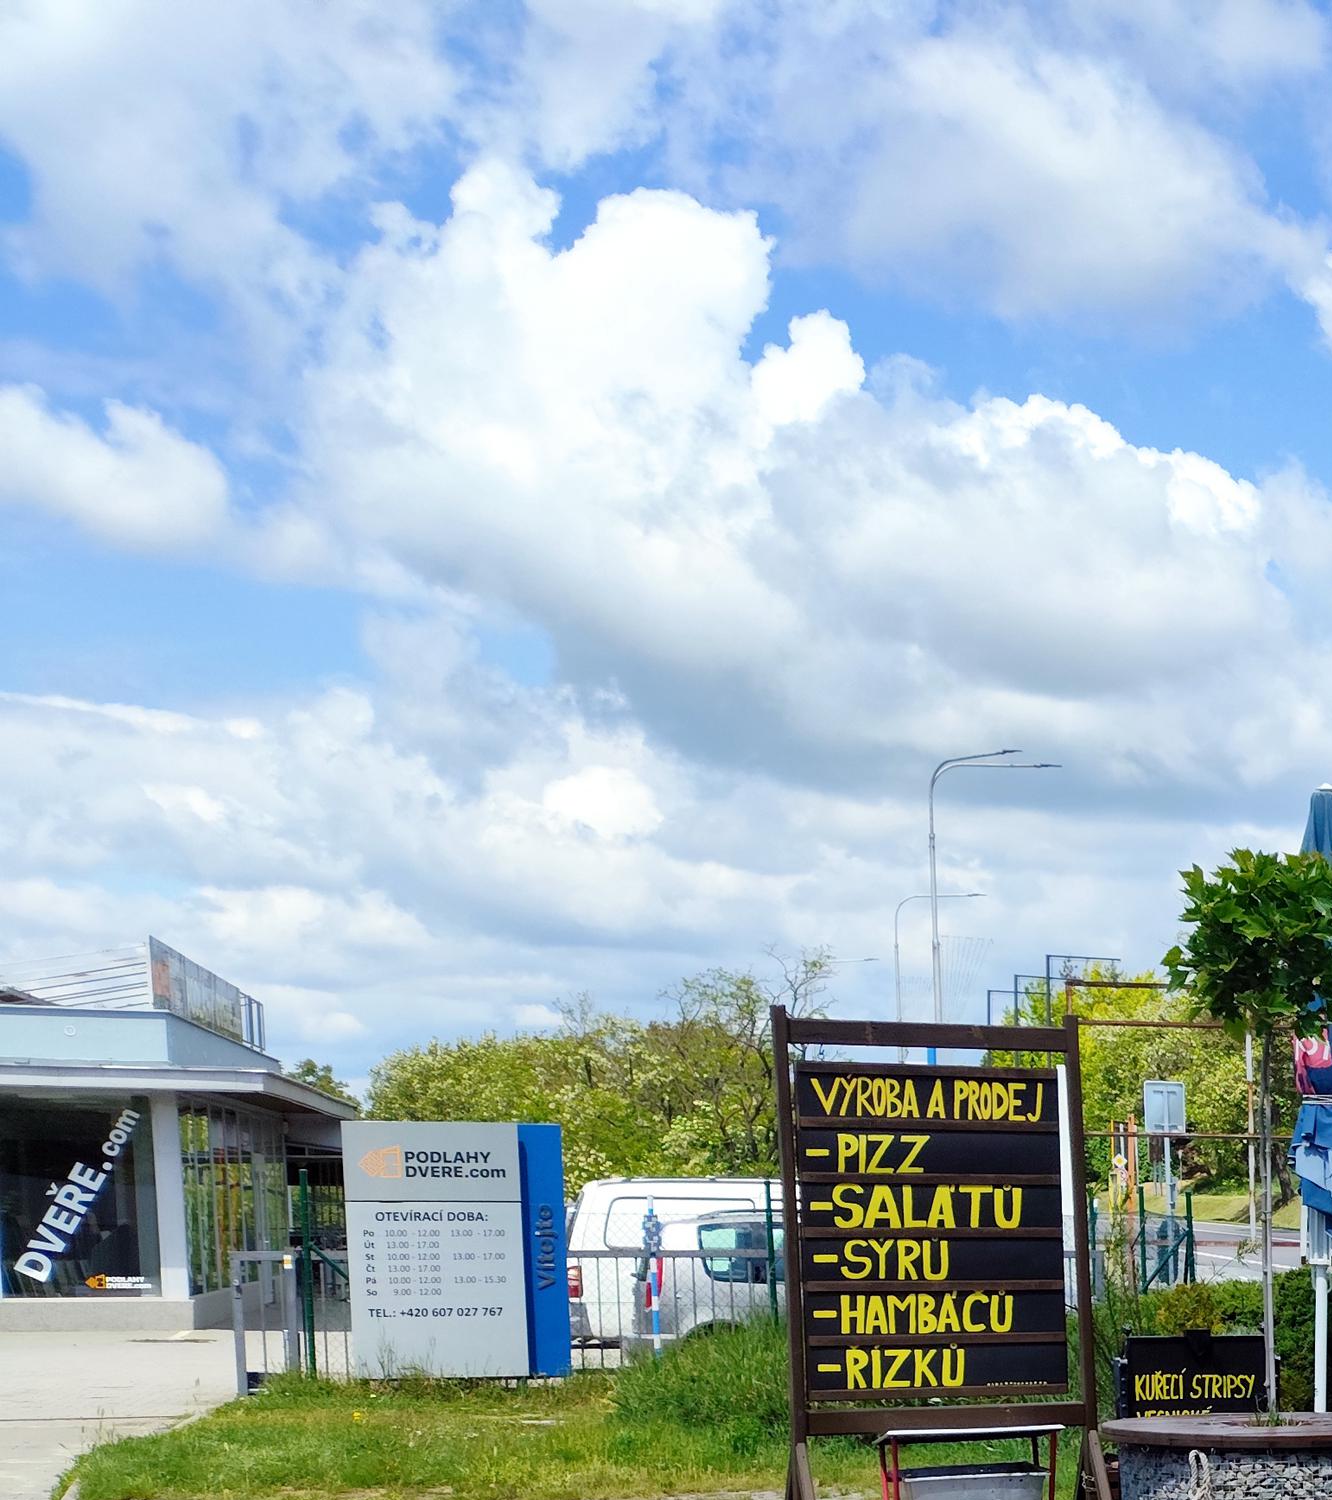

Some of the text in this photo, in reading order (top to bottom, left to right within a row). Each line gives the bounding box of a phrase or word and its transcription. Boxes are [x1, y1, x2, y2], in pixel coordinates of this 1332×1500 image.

[810, 1075, 1043, 1123] VÝROBA A PRODEJ
[404, 1151, 491, 1164] PODLAHY
[405, 1166, 507, 1178] DVERE.com
[13, 1108, 141, 1283] DVEŘE.com
[375, 1209, 489, 1222] OTEVÍRACÍ DOBA:
[363, 1229, 375, 1238] Po
[385, 1229, 408, 1238] 10.00
[418, 1229, 441, 1238] 12.00
[483, 1229, 506, 1238] 17.00
[364, 1240, 375, 1249] Út
[417, 1240, 440, 1249] 17.00
[365, 1253, 375, 1261] St
[483, 1252, 506, 1261] 17.00
[366, 1264, 376, 1273] Čt
[419, 1264, 441, 1273] 17.00
[367, 1288, 378, 1297] So
[368, 1307, 503, 1318] TEL.: +420 607 027 767
[1135, 1367, 1255, 1401] KUŘECÍ STRIPSY
